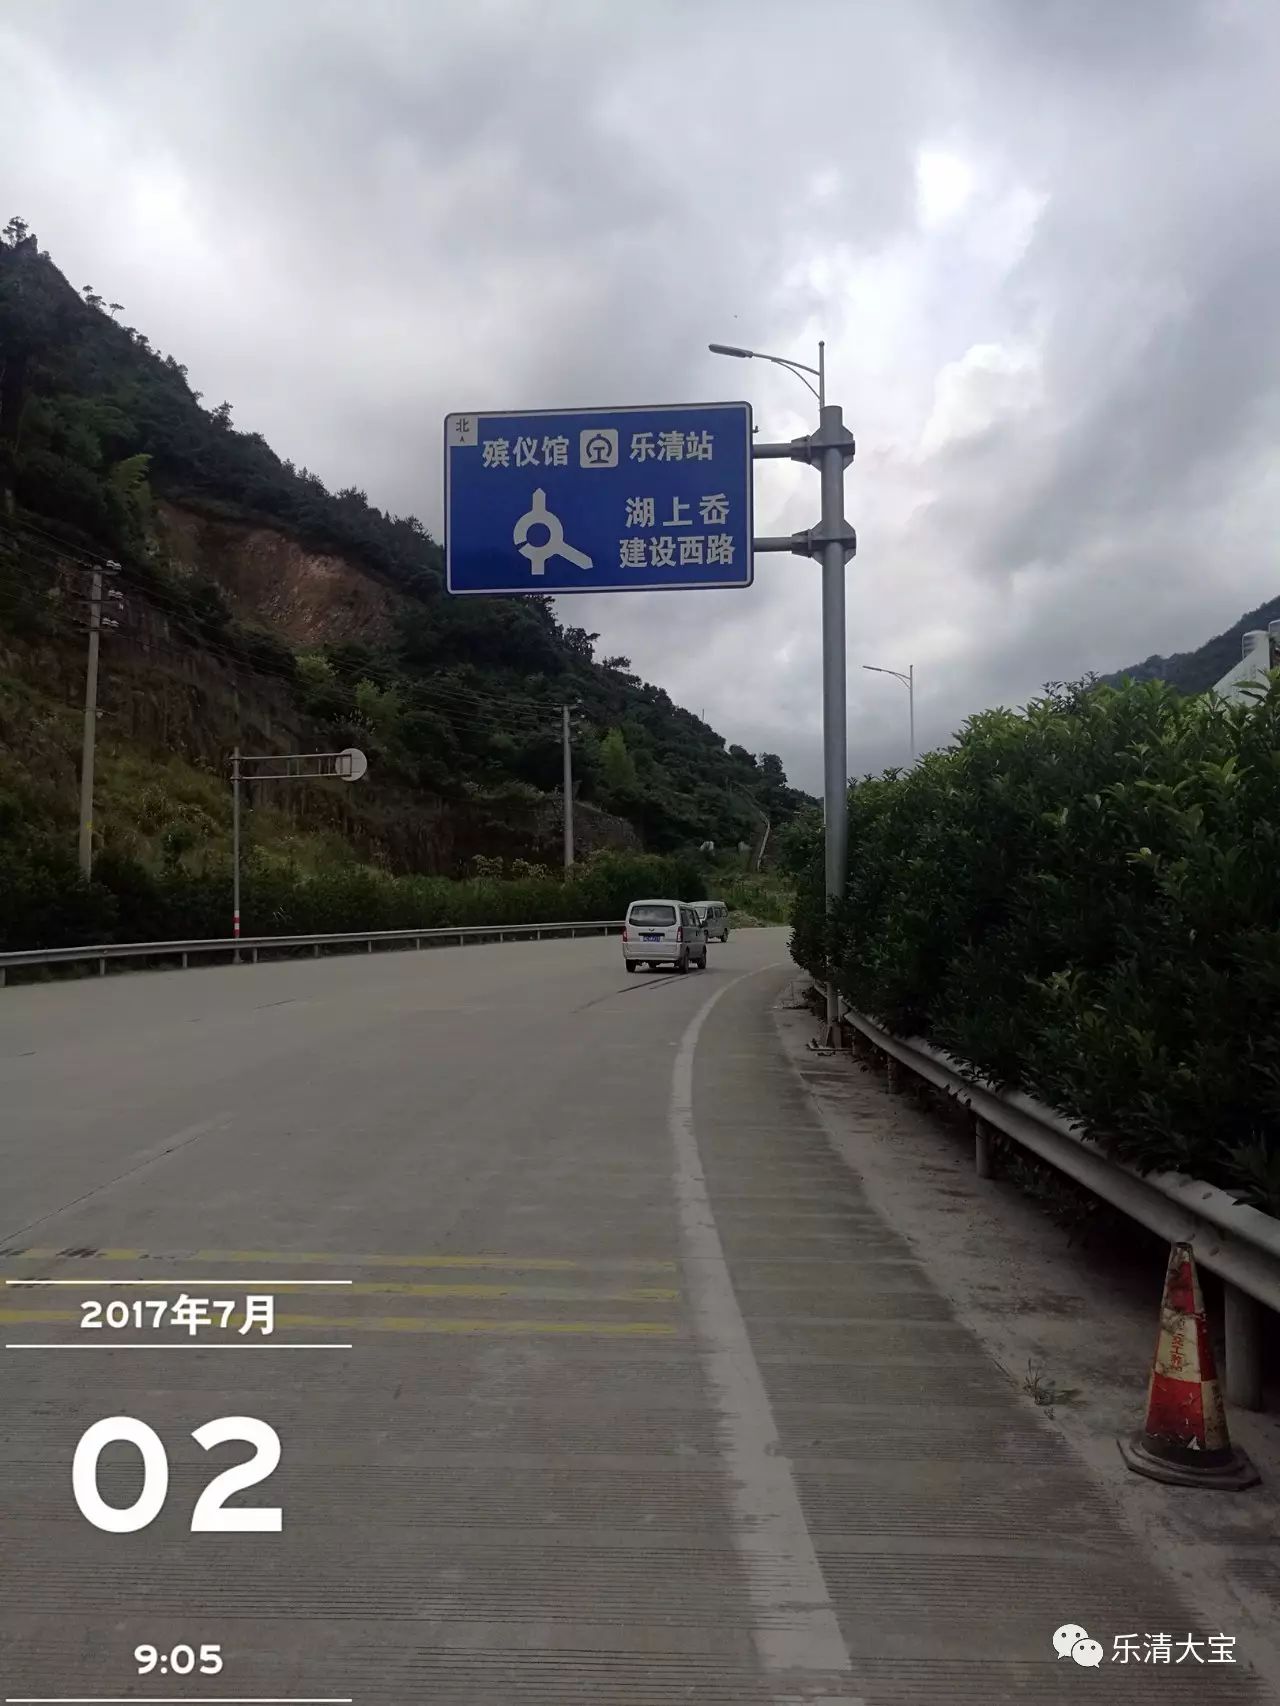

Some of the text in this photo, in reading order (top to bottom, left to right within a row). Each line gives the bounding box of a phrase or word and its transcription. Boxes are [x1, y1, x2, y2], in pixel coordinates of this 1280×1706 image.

[455, 418, 470, 433] 北
[482, 435, 570, 468] 殡仪馆
[629, 430, 714, 463] 乐清站
[624, 493, 730, 528] 湖上岙
[619, 534, 735, 569] 建设西路
